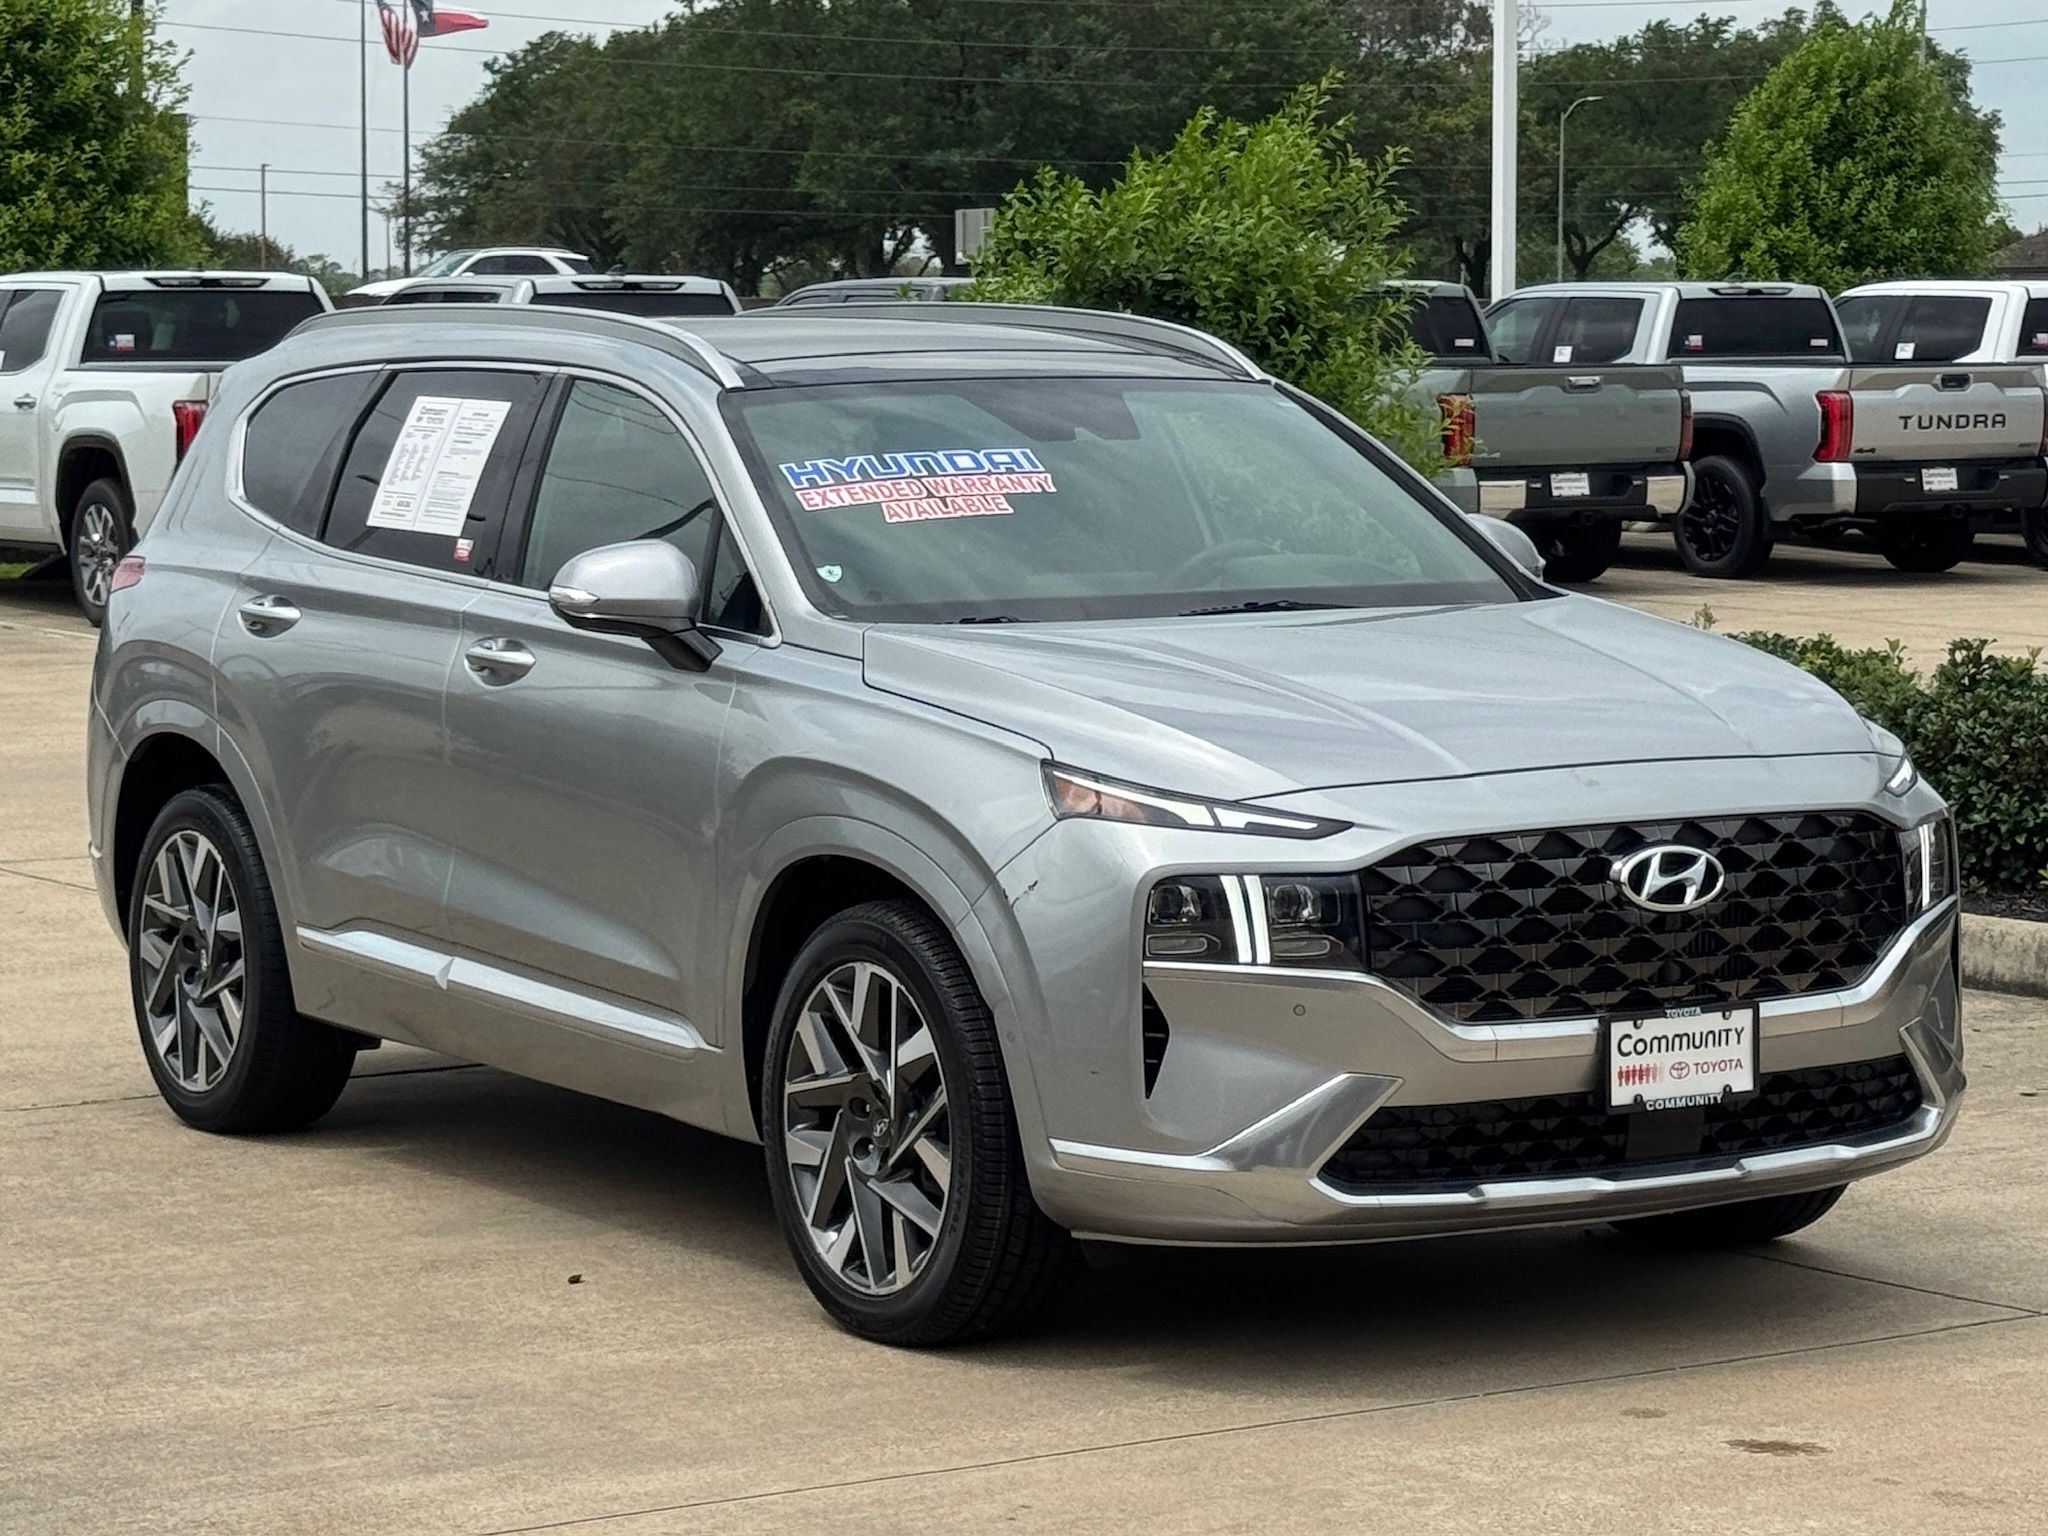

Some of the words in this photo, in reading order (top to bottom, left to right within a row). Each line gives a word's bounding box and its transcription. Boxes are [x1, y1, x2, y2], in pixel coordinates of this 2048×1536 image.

[1899, 414, 2006, 430] TUNDRA
[780, 449, 1045, 488] HYUNDAI
[800, 478, 924, 509] EXTENDED
[925, 473, 1054, 496] WARRANTY
[884, 496, 1009, 521] AVAILABLE
[1664, 1007, 1702, 1018] TOYOTA
[1693, 1058, 1744, 1076] TOYOTA
[1645, 1093, 1723, 1111] COMMUNITY
